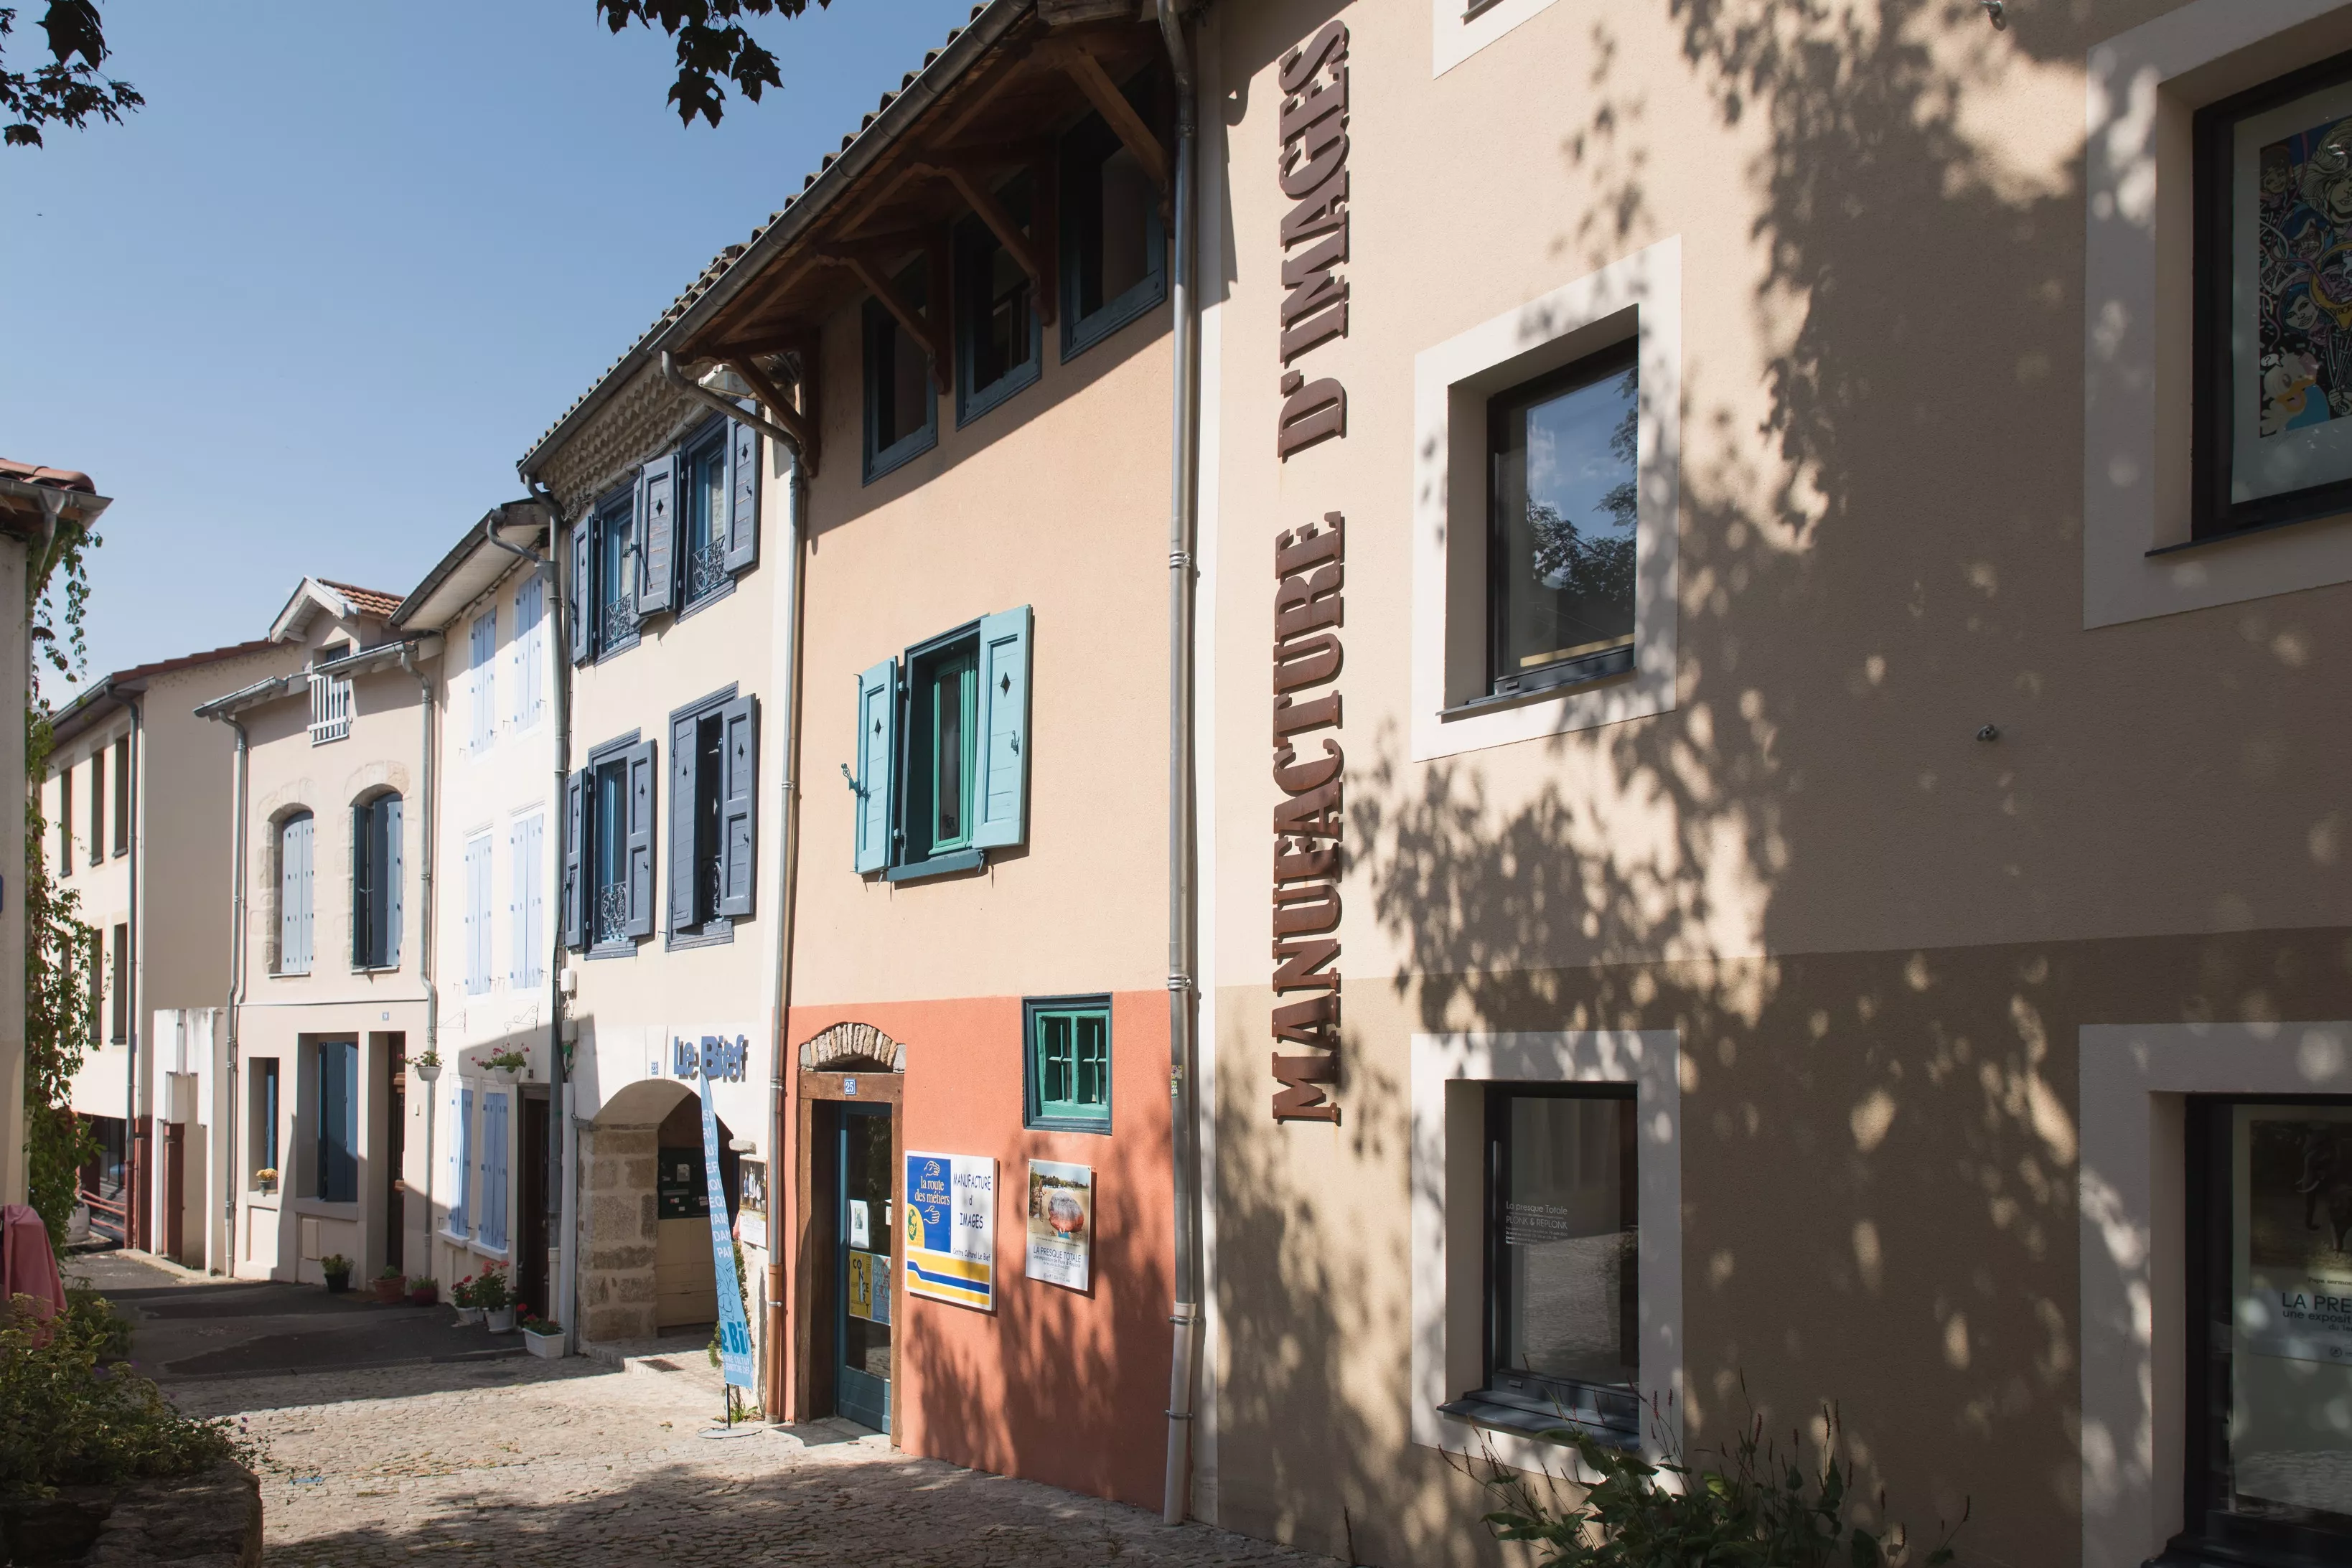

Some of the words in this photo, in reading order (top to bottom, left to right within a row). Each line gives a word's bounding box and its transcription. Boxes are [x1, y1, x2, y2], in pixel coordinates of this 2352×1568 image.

[1278, 19, 1348, 461] D'IMAGES
[1272, 510, 1344, 1125] MANUFACTURE
[673, 1036, 695, 1076] Le
[701, 1033, 745, 1078] Bief
[845, 1081, 854, 1093] 25
[921, 1176, 927, 1188] la
[928, 1180, 945, 1191] route
[953, 1174, 991, 1191] MANUFACTURE
[915, 1189, 926, 1201] des
[927, 1191, 950, 1205] métiers
[969, 1195, 974, 1205] d'
[1507, 1201, 1514, 1209] La
[1517, 1204, 1544, 1213] presque
[1545, 1205, 1568, 1215] Totale
[960, 1213, 983, 1229] IMAGES
[1507, 1216, 1529, 1225] PLONK
[1537, 1219, 1568, 1229] REPLONK
[965, 1250, 978, 1259] Culturel
[1041, 1247, 1063, 1259] PRESQUE
[1064, 1252, 1082, 1262] TOTALE
[2282, 1292, 2307, 1309] LA
[2315, 1295, 2352, 1313] PRE
[2282, 1310, 2305, 1319] une
